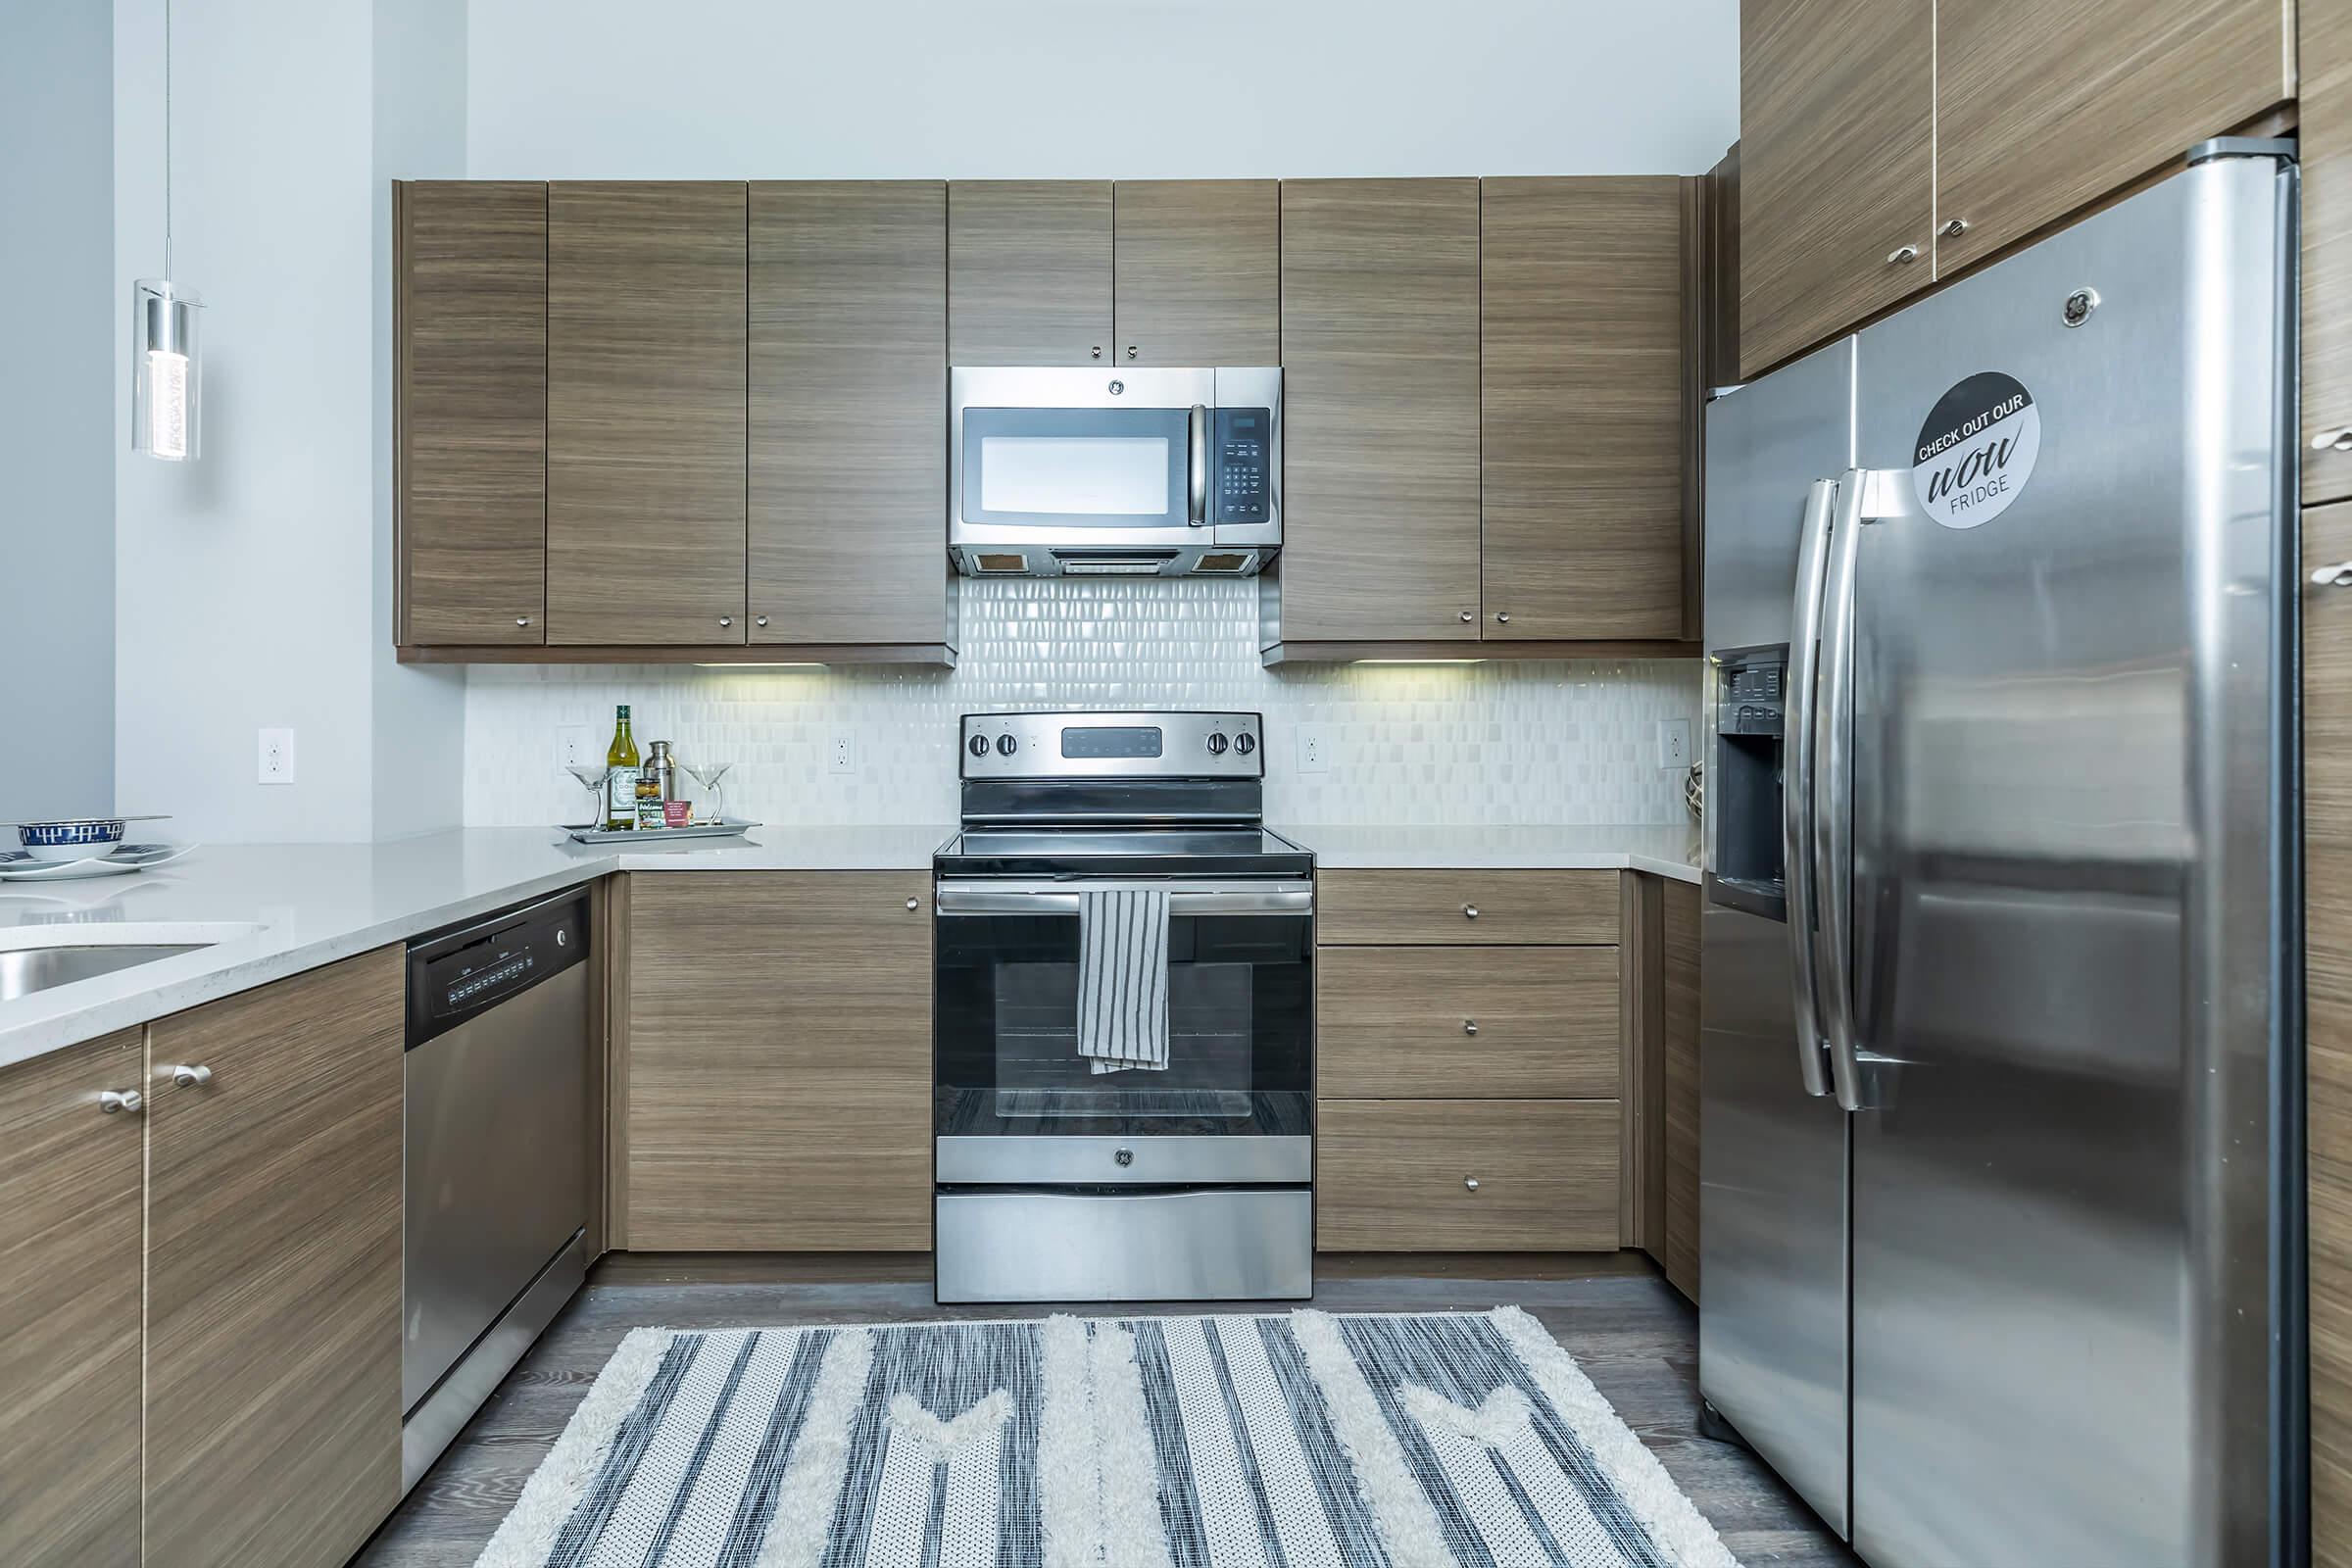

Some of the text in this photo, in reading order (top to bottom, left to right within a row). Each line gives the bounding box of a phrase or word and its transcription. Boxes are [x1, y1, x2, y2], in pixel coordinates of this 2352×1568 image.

[1919, 394, 2024, 461] CHECK OUT OUR
[1950, 474, 2010, 514] FRIDGE
